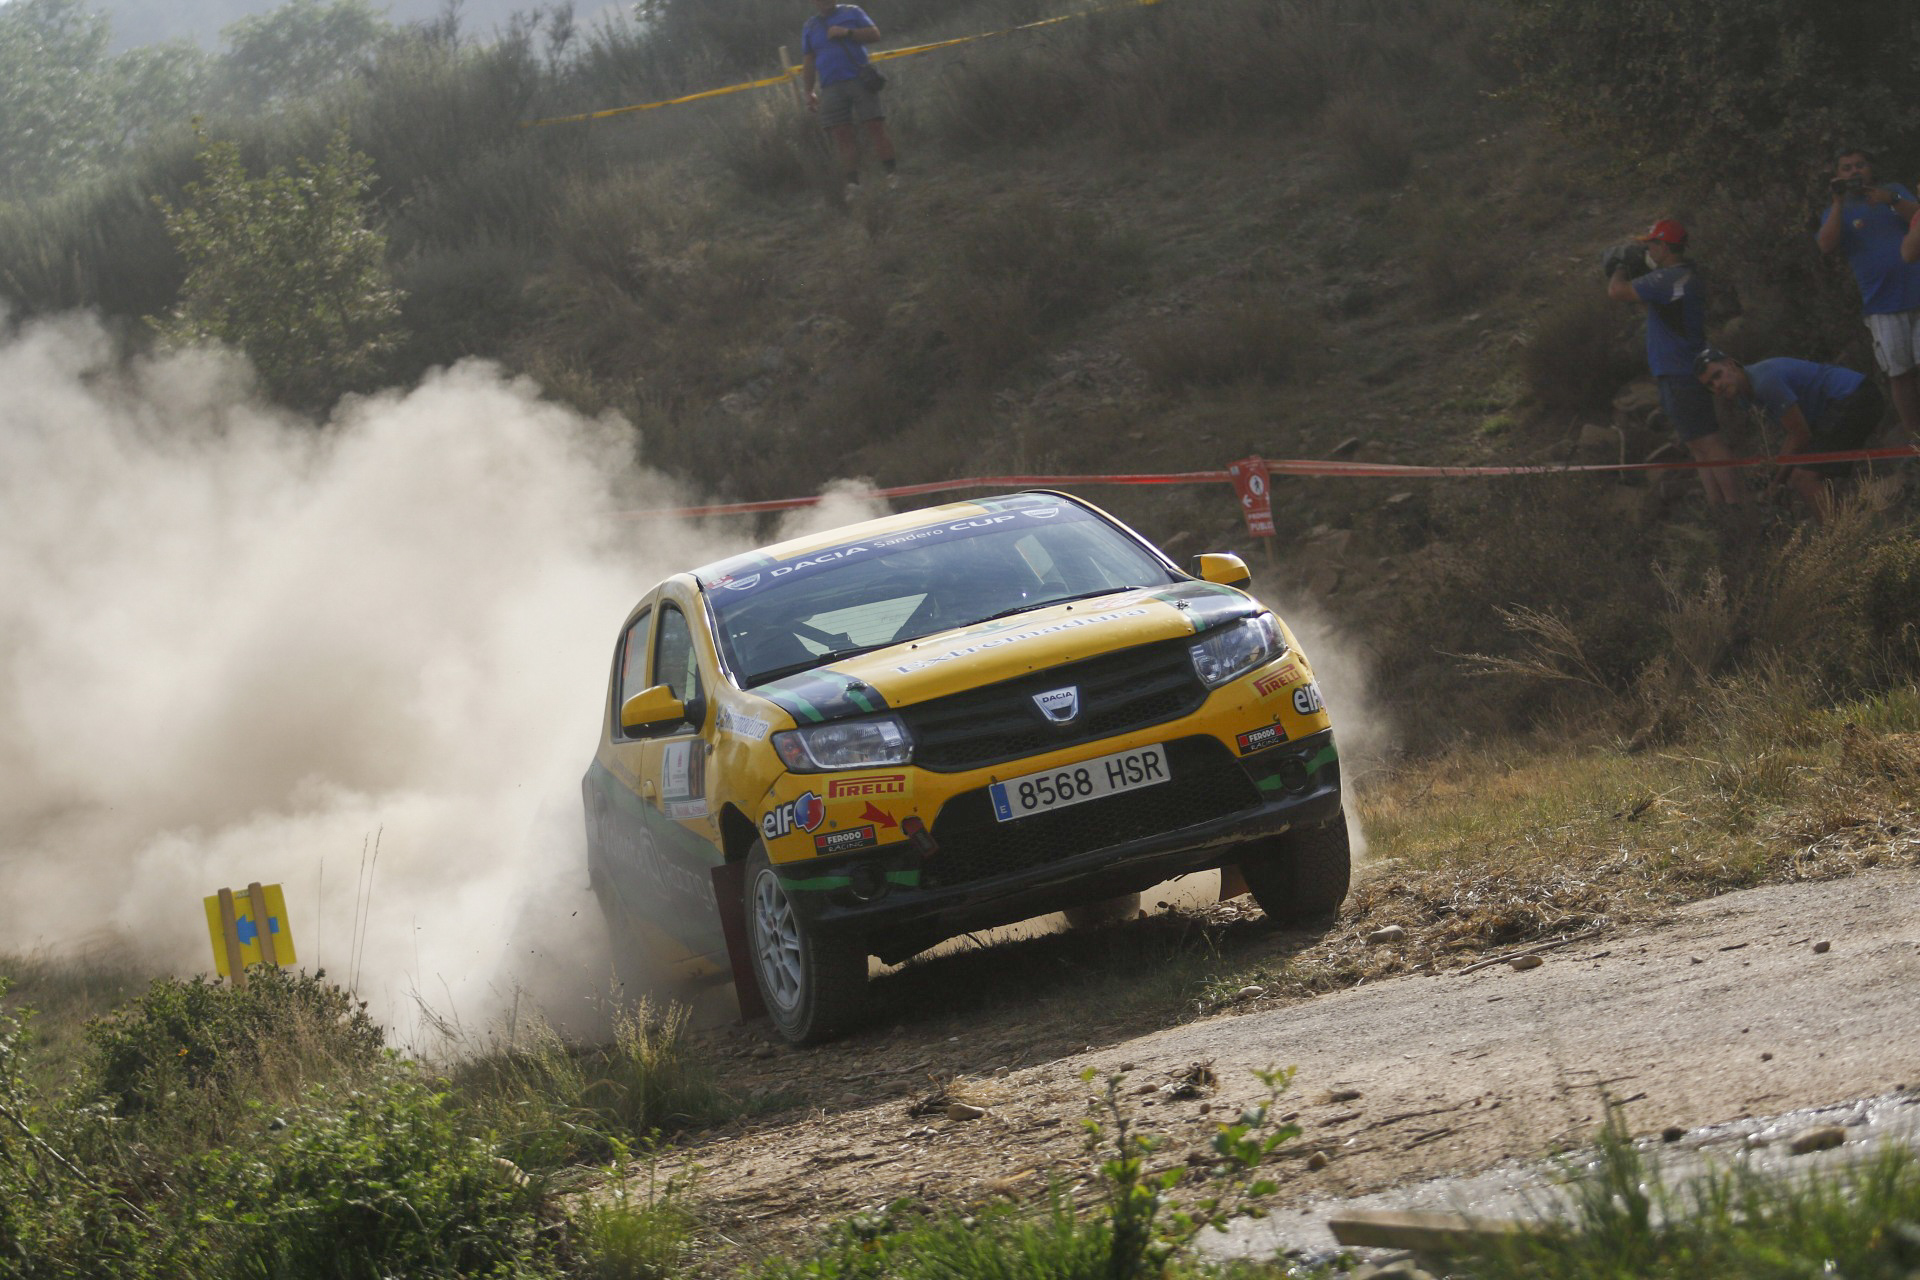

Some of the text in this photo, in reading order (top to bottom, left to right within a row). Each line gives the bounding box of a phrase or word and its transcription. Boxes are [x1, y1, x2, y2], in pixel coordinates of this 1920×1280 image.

[771, 515, 1016, 577] DACIA Sandero CUP
[1253, 663, 1301, 697] PIRELLI
[1042, 691, 1073, 703] DACIA
[1249, 728, 1275, 742] FERODO
[828, 774, 906, 799] PIRELLI
[1000, 751, 1163, 814] E 8568 HSR
[763, 803, 793, 838] elf
[827, 831, 861, 845] FERODO
[828, 841, 864, 852] RACING
